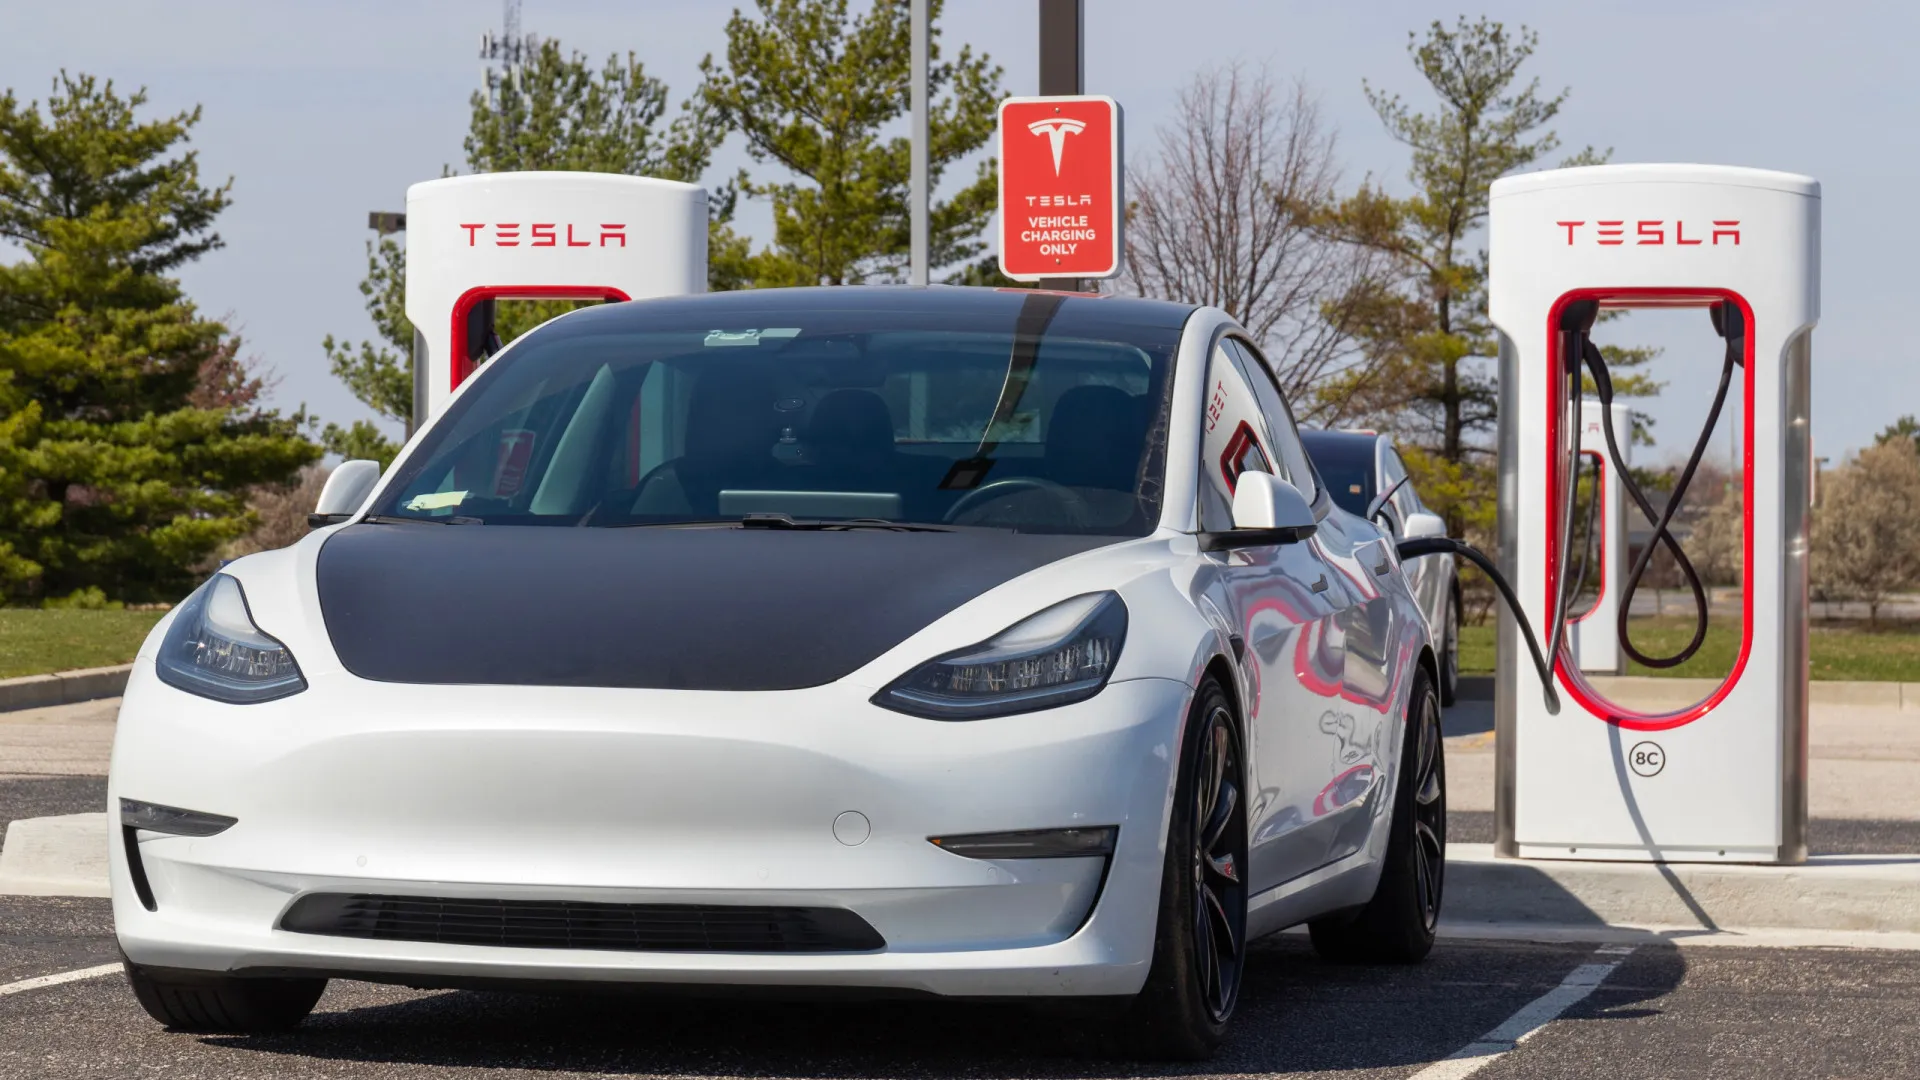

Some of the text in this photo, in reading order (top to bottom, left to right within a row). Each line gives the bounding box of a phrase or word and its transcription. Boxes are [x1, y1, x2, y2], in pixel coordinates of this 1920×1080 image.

[1025, 194, 1091, 207] TESLA
[1028, 215, 1088, 228] VEHICLE
[460, 222, 627, 248] TESLA
[1020, 229, 1096, 242] CHARGING
[1557, 219, 1741, 246] TESLA
[1039, 243, 1078, 255] ONLY
[1636, 751, 1658, 765] 8C
